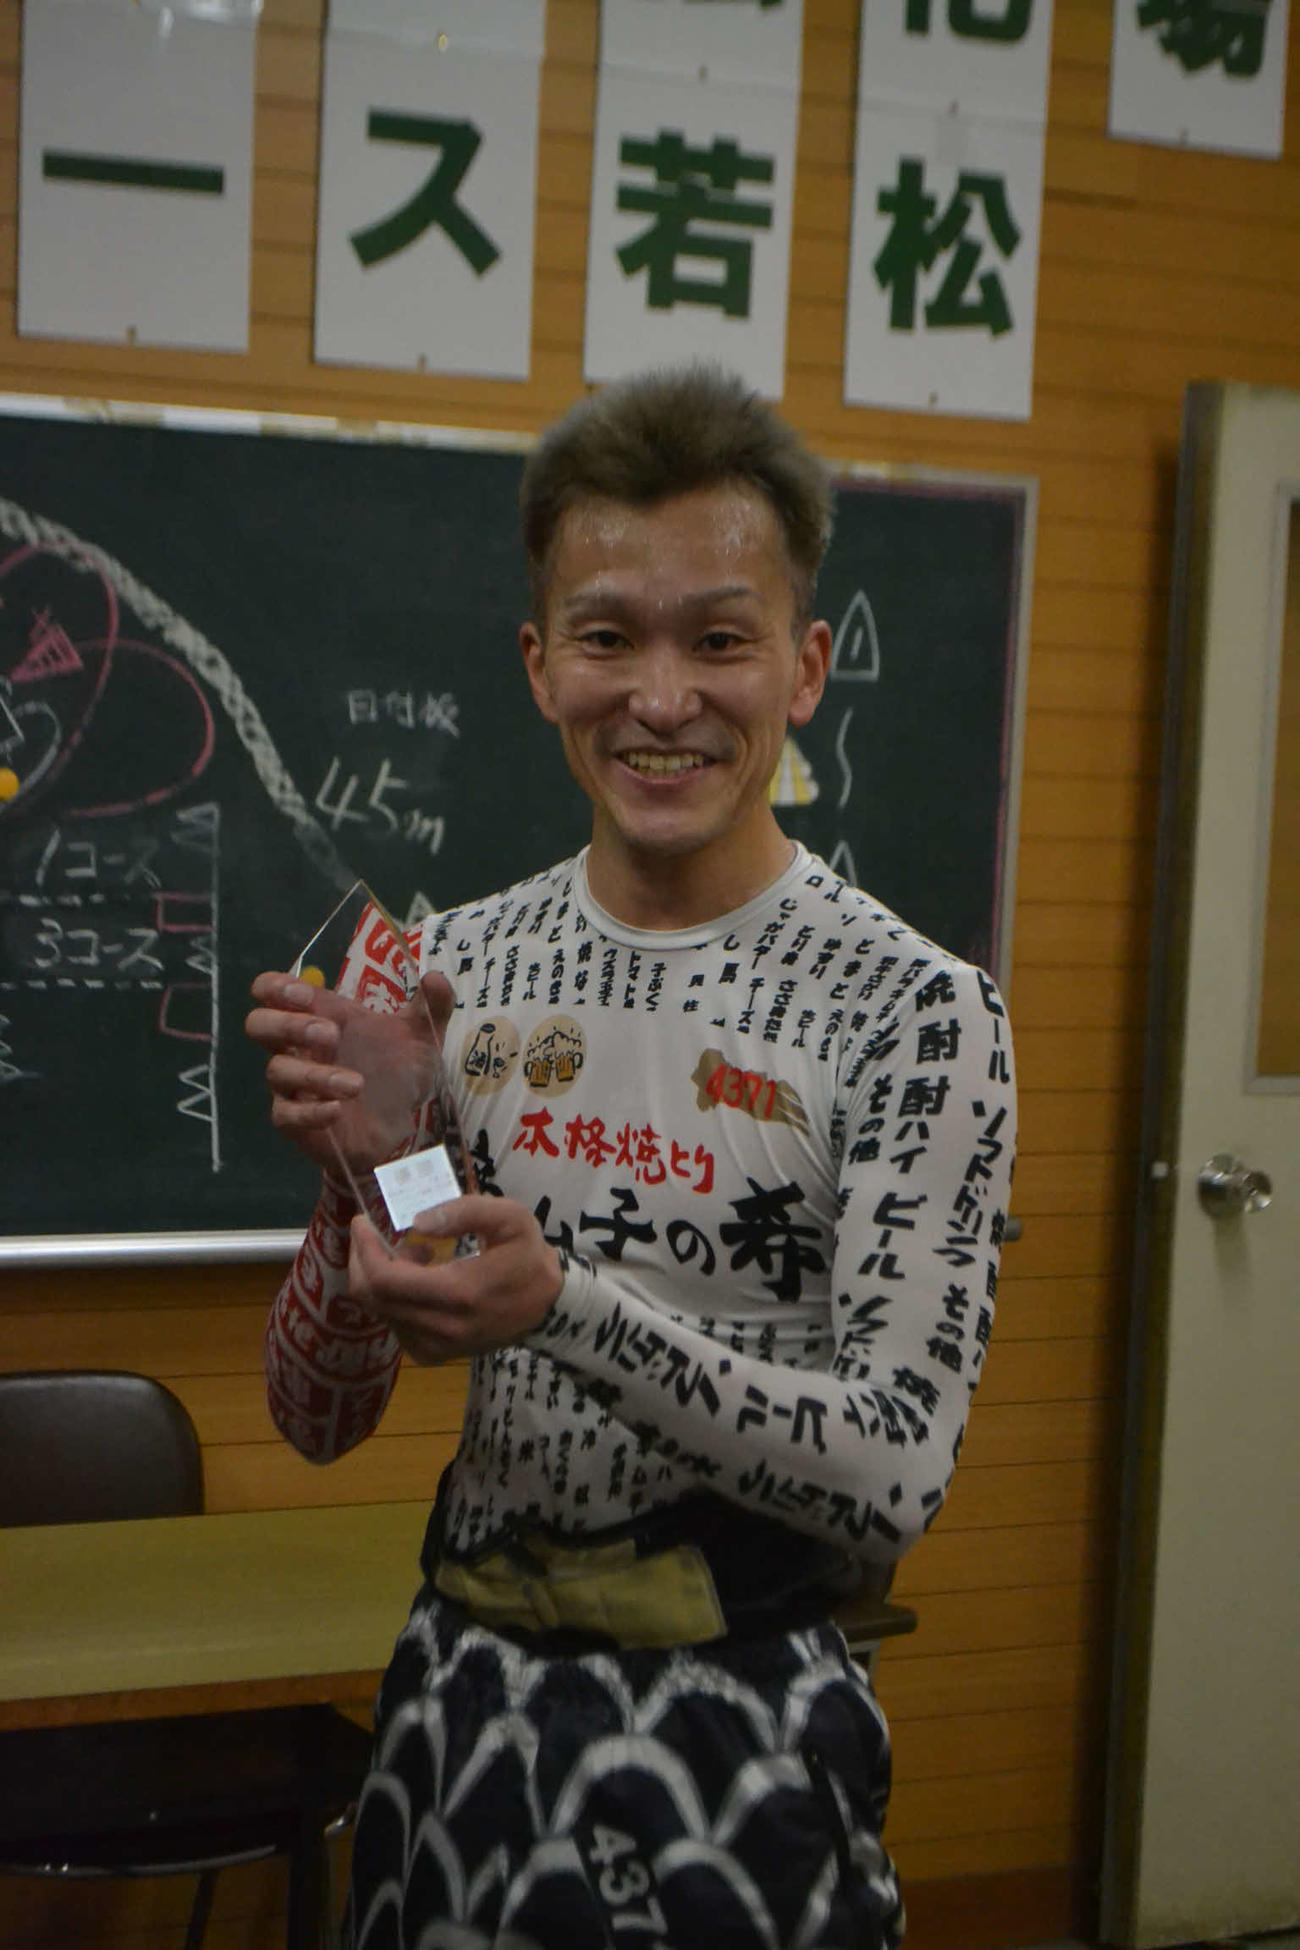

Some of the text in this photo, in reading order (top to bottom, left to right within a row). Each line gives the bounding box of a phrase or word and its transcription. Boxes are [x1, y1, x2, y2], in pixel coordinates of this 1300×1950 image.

[33, 917, 165, 971] 3コース
[705, 1064, 778, 1120] 4371
[512, 1106, 715, 1194] 本格焼とり
[872, 1191, 928, 1280] ビール
[589, 1823, 670, 1950] 437
